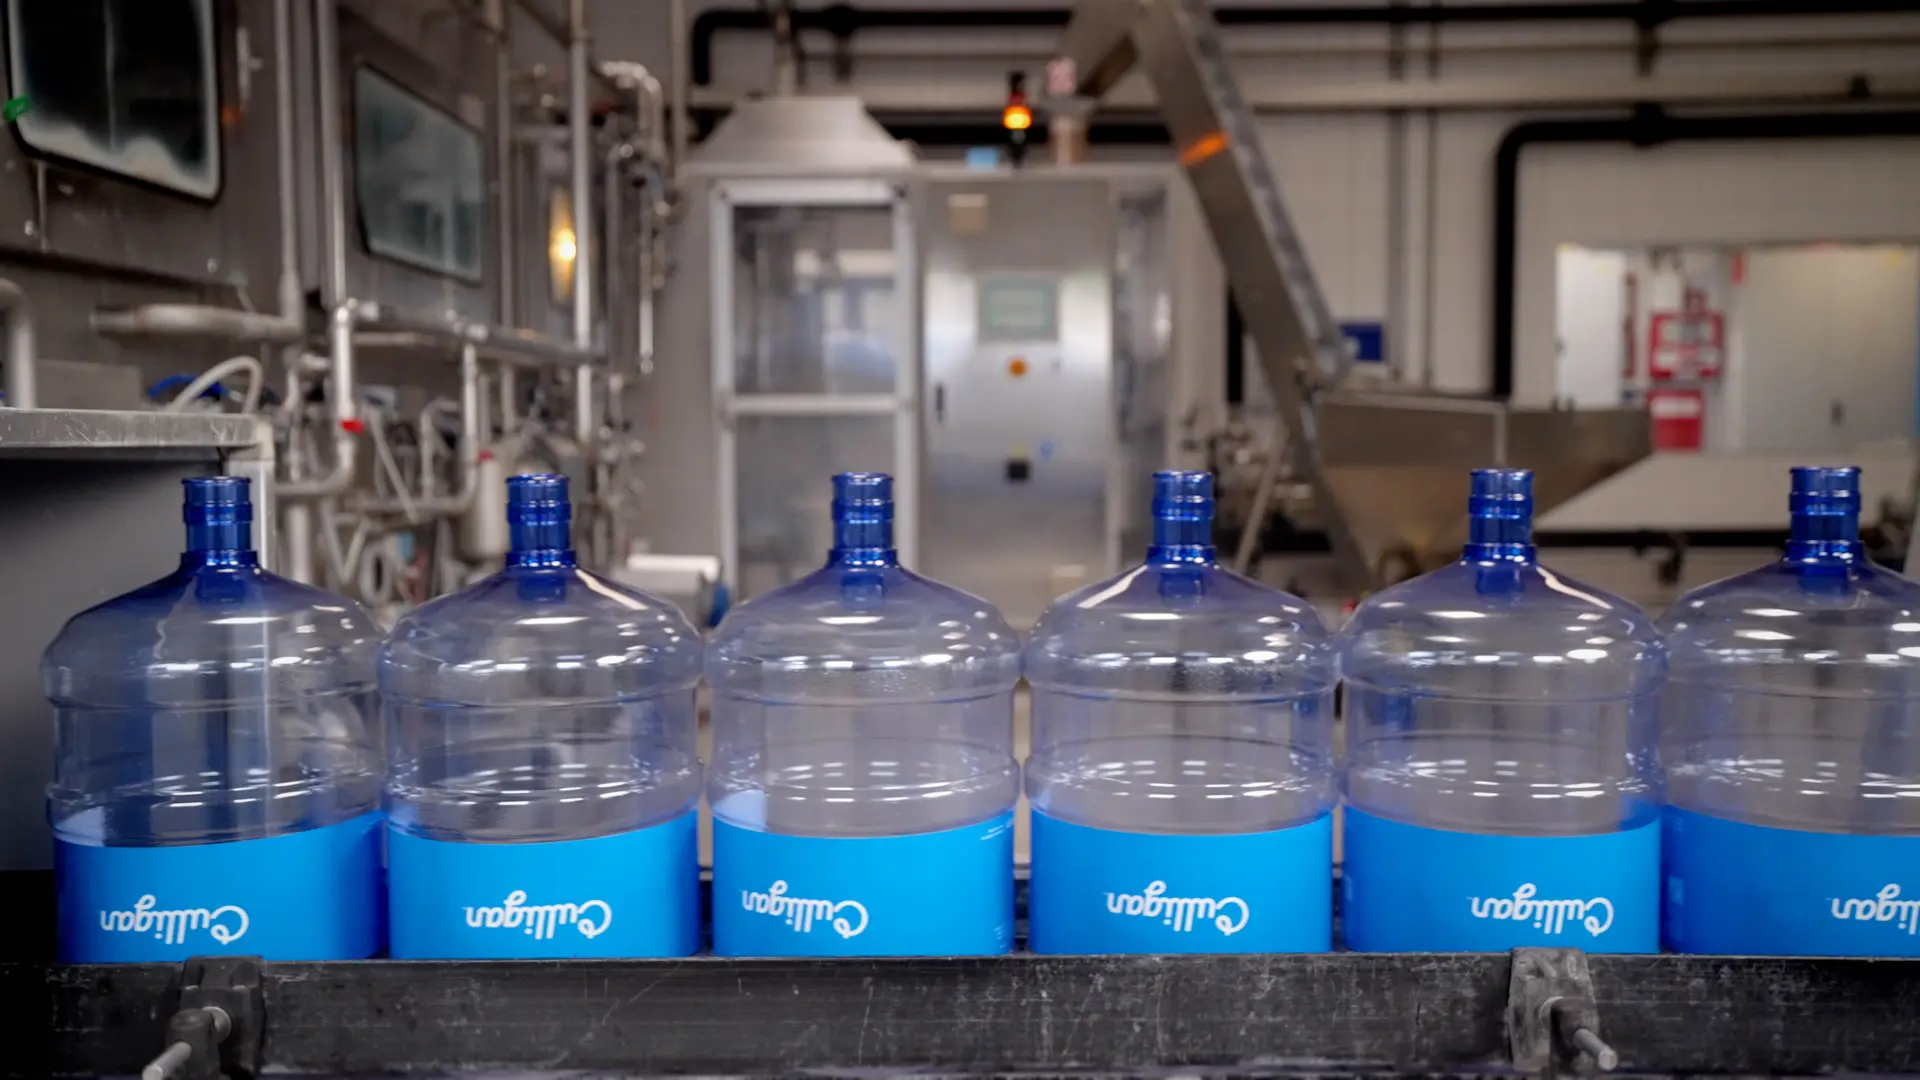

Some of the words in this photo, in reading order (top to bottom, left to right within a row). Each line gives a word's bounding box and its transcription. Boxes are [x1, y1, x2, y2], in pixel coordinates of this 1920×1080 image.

[100, 894, 249, 945] Culligan
[466, 890, 612, 940] Culligan
[742, 880, 869, 939] Culligan
[1106, 880, 1250, 936] Culligan
[1471, 883, 1614, 937] Culligan
[1831, 883, 1920, 935] ligan
